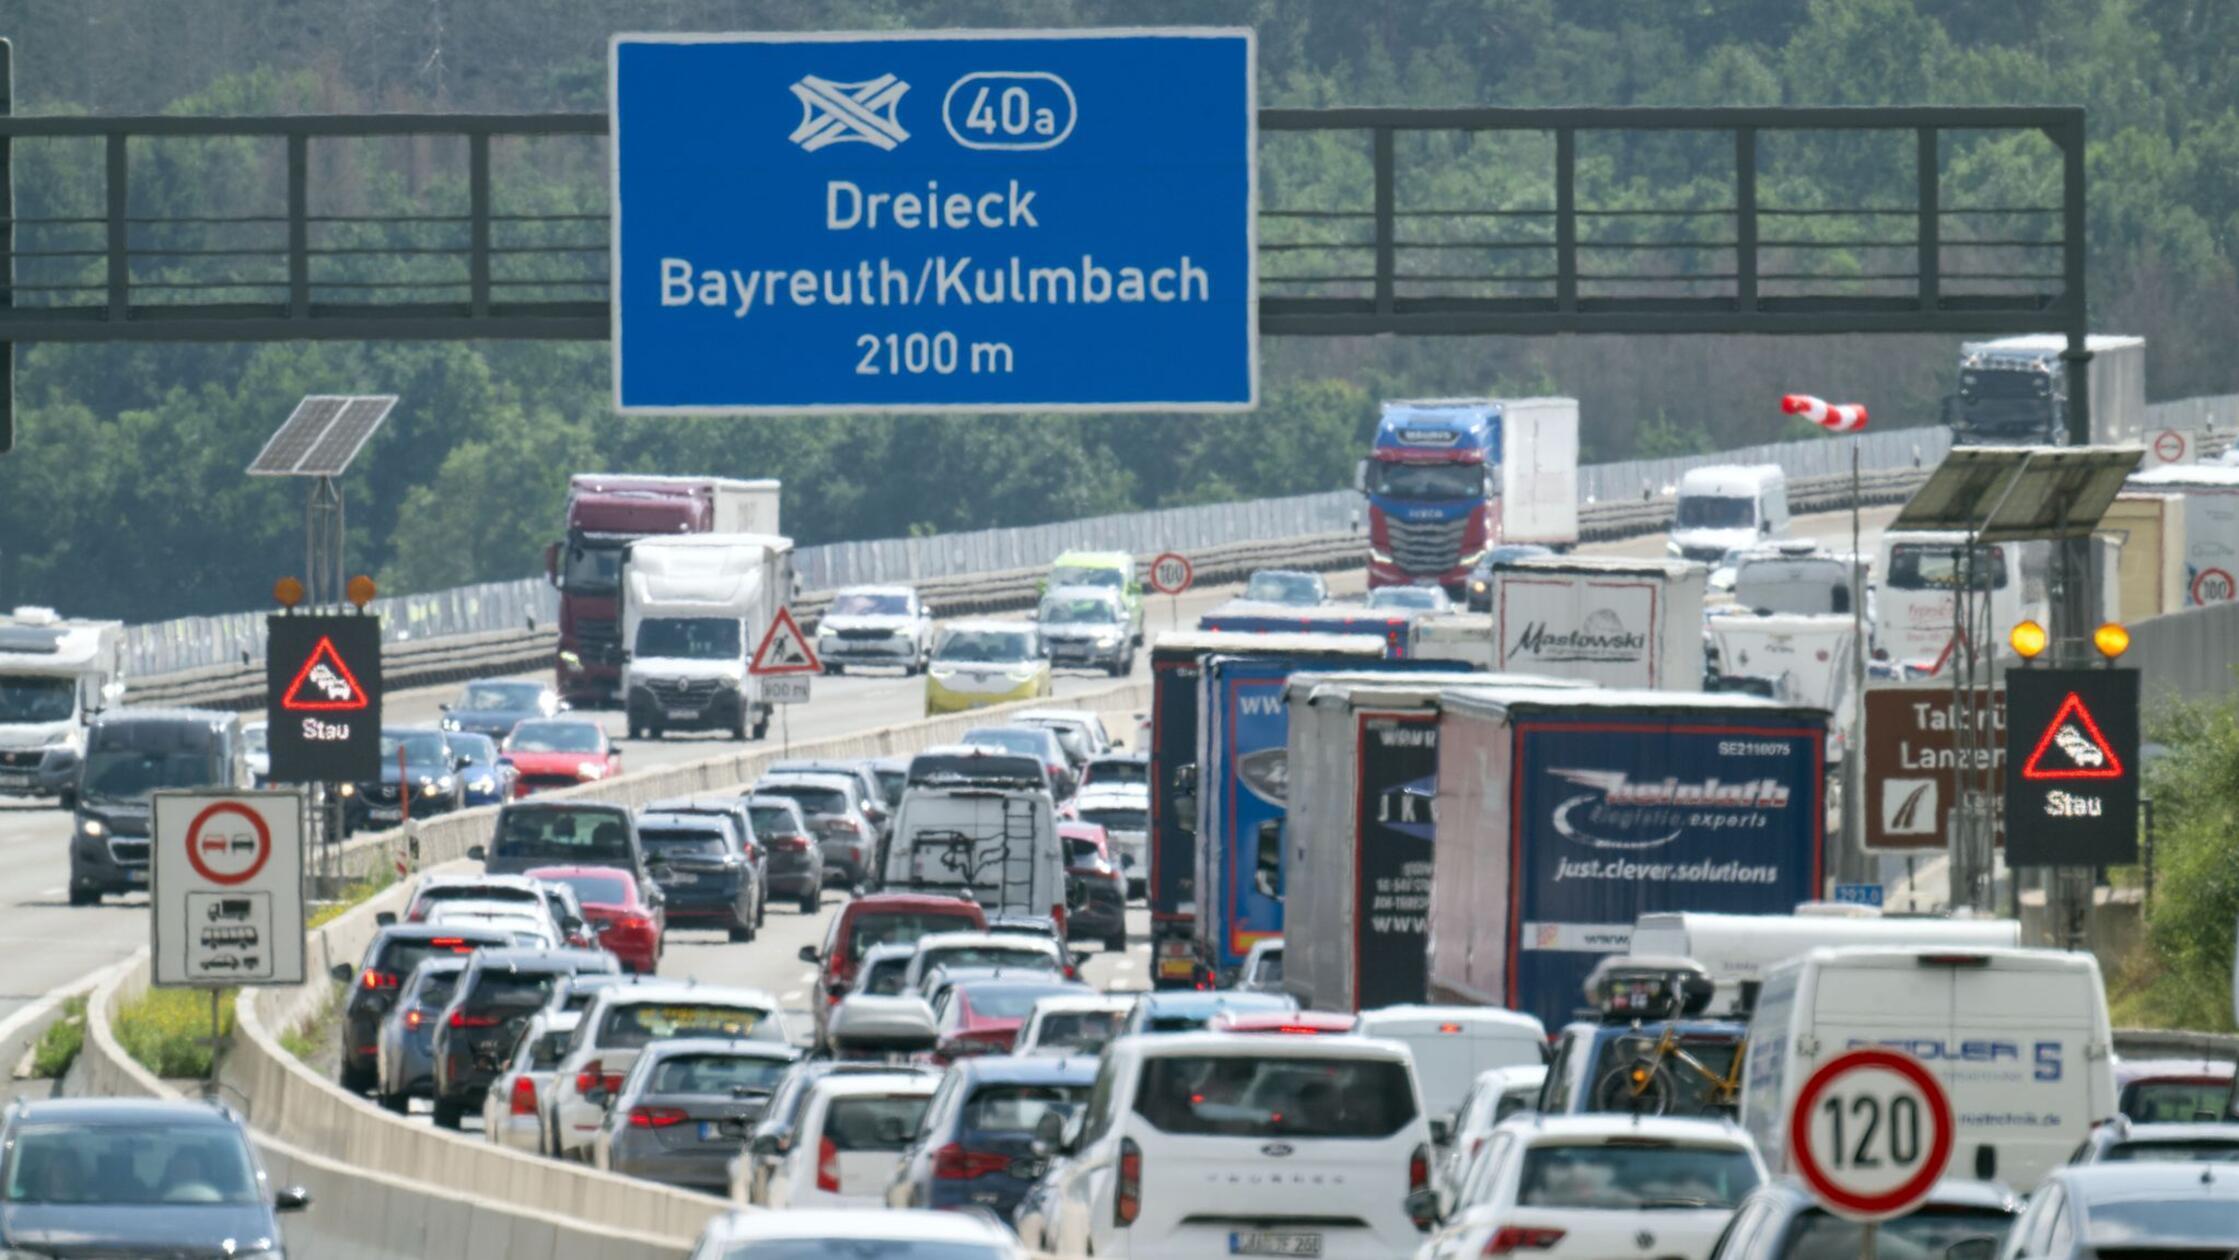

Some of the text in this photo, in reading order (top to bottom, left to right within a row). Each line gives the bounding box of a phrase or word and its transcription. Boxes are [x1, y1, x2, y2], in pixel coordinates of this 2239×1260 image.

[965, 86, 1056, 136] 40a
[826, 180, 1039, 230] Dreieck
[660, 256, 1210, 318] Bayreuth/Kulmbach
[855, 331, 1013, 376] 2100 m
[302, 717, 350, 740] Stau
[2045, 790, 2102, 817] Stau
[1823, 1094, 1921, 1169] 120
